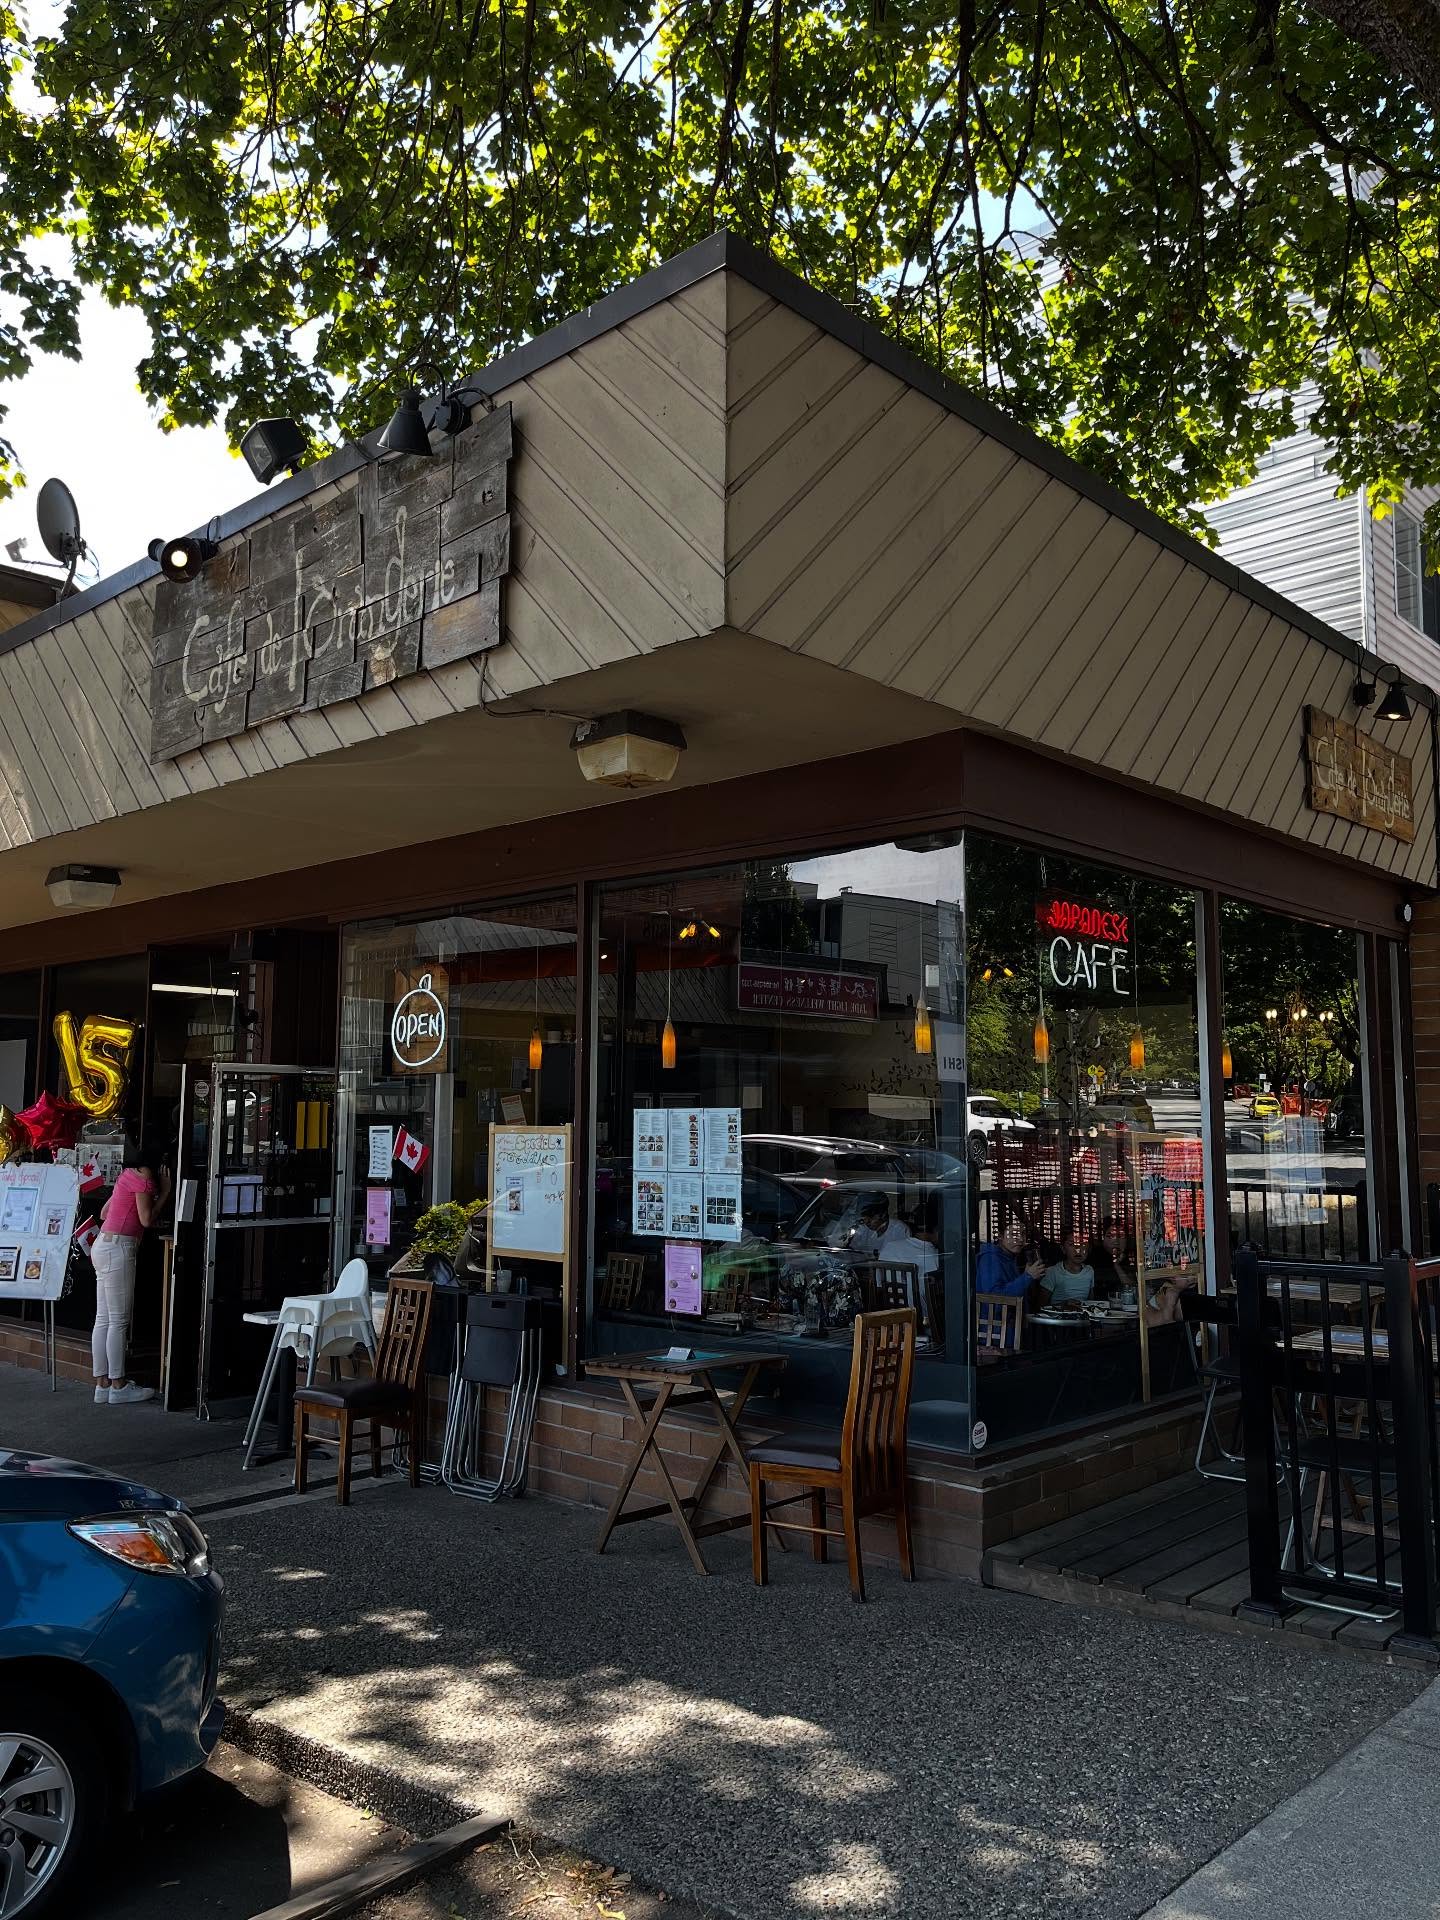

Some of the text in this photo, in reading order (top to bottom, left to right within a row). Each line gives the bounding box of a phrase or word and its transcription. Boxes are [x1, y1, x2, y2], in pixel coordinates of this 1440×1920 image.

[182, 599, 248, 713] Cafe
[261, 612, 282, 675] de
[1049, 935, 1130, 995] CAFE
[395, 1011, 441, 1049] OPEN
